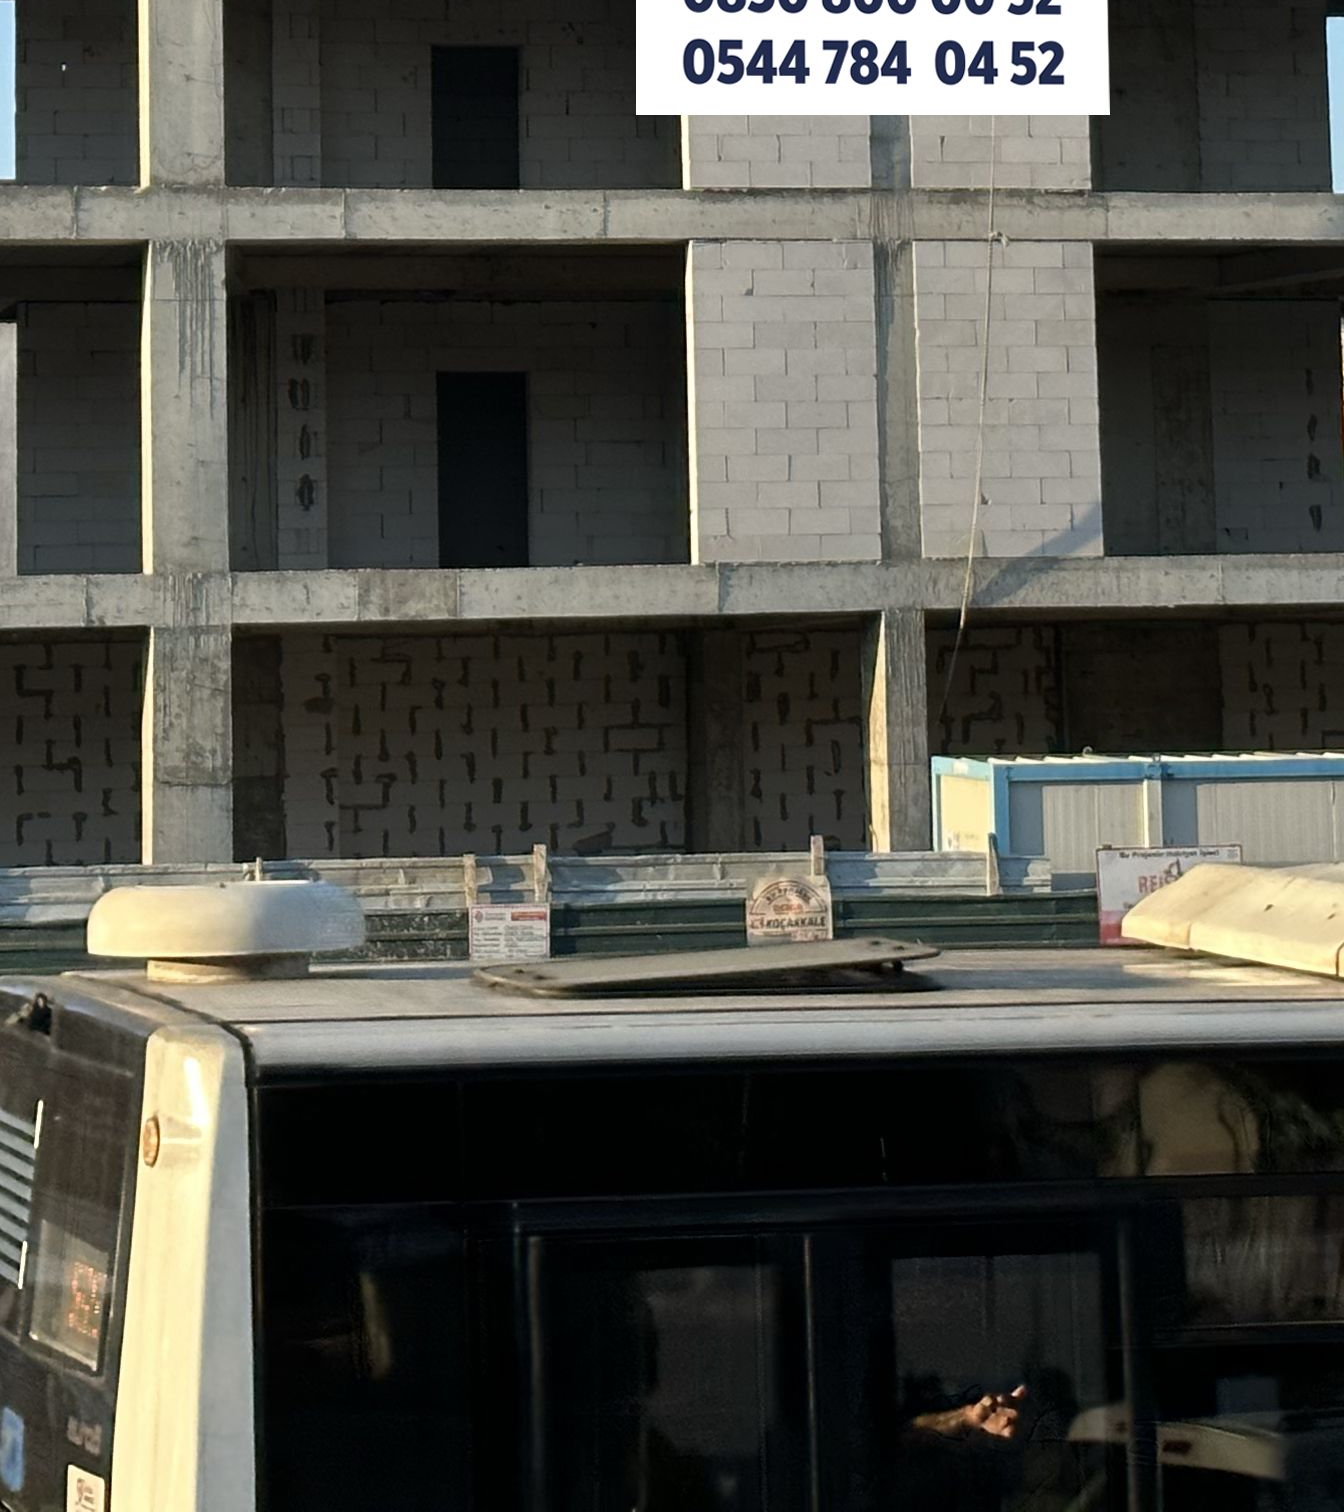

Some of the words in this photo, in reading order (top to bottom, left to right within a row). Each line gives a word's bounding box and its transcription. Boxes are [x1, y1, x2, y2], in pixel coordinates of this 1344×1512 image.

[682, 38, 810, 86] 0544
[822, 39, 912, 86] 784
[934, 40, 998, 86] 04
[1010, 40, 1066, 86] 52
